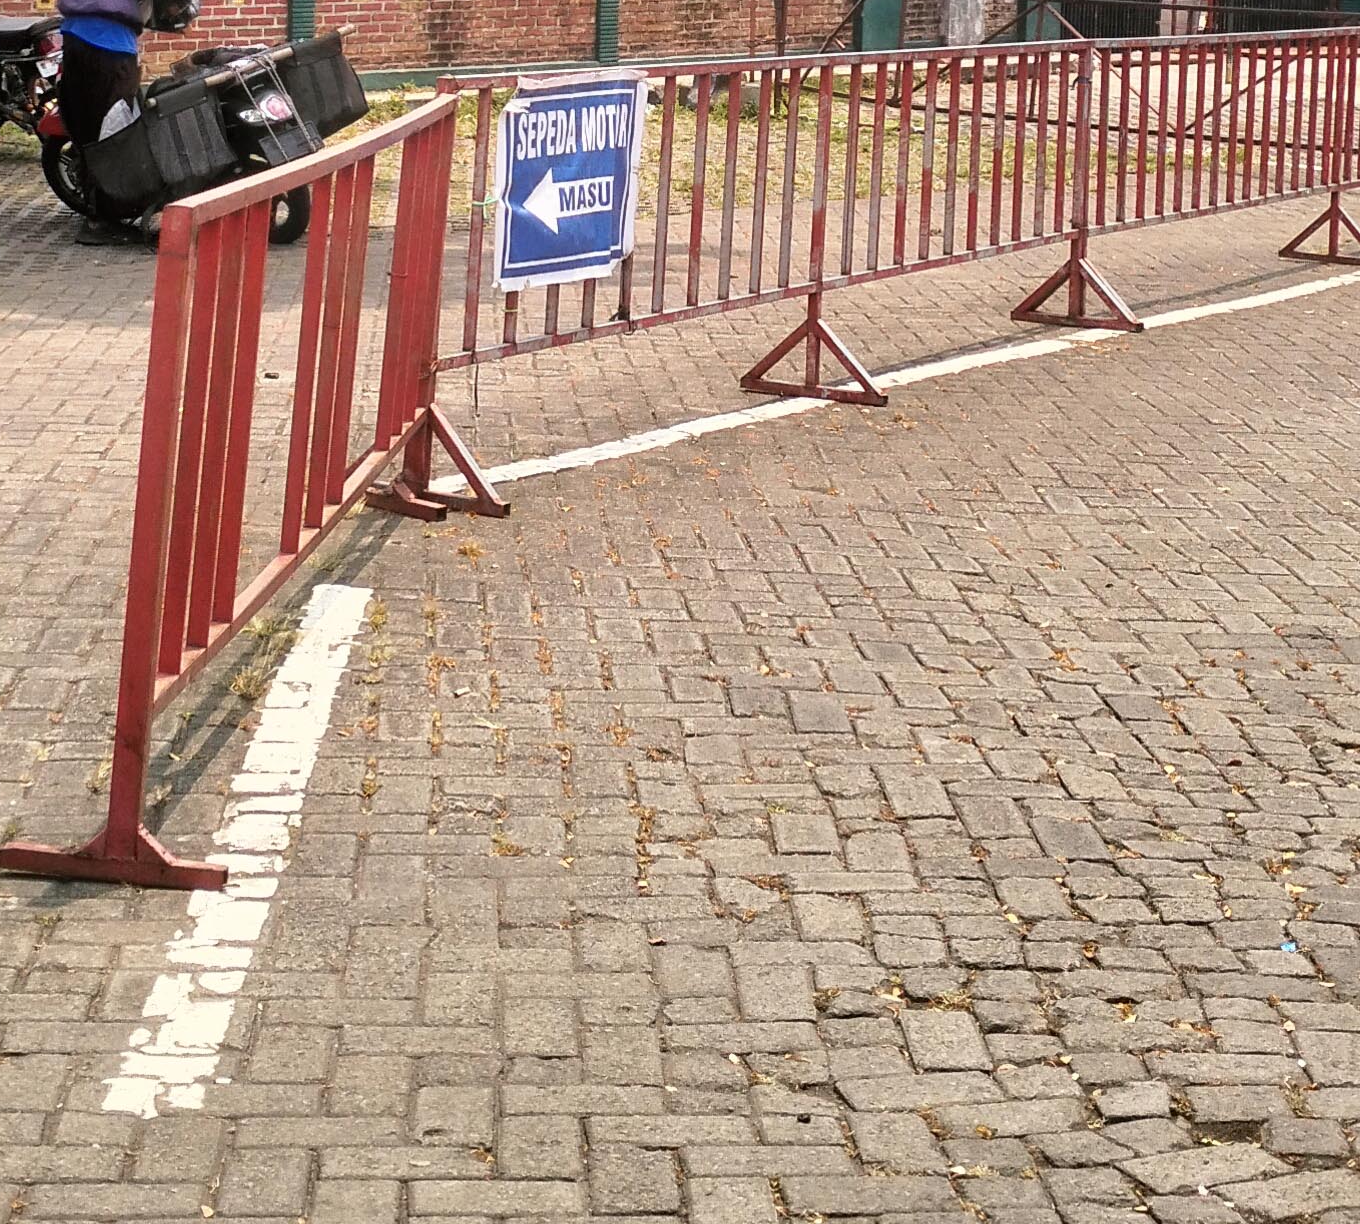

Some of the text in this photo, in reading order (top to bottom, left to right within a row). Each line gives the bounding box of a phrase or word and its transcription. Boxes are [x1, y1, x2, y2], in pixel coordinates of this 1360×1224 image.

[516, 103, 629, 161] SEPEDA MOTR
[558, 180, 611, 213] MASU
